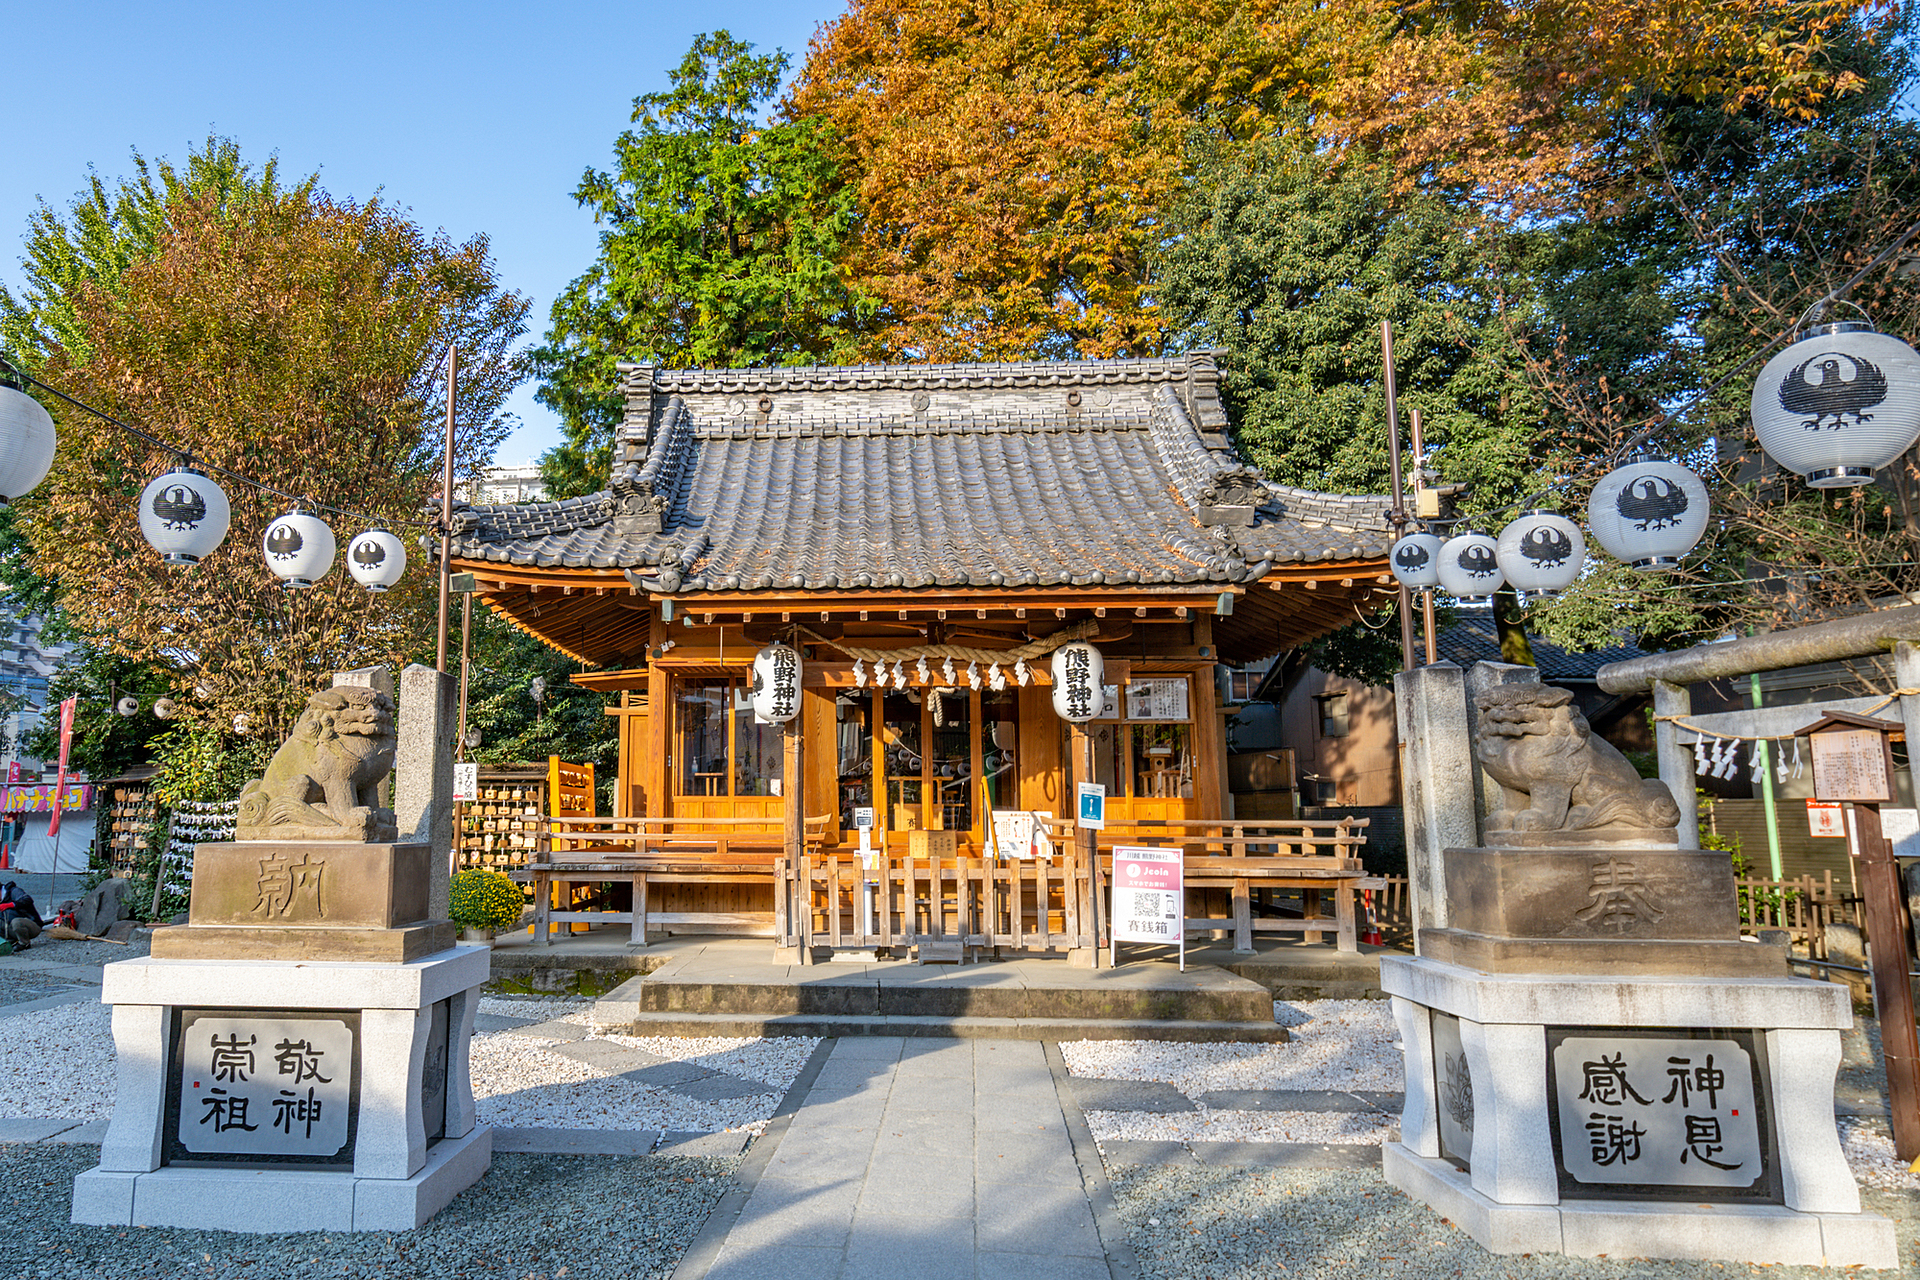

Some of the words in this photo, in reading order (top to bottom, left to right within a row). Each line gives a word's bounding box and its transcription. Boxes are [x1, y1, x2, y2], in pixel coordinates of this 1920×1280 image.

[771, 648, 797, 716] 熊野神社
[1065, 648, 1092, 717] 熊野神社
[3, 788, 84, 811] バナナチョコ
[250, 852, 329, 919] 納
[1575, 856, 1666, 934] 奉
[1128, 920, 1168, 934] 賽銭箱
[200, 1033, 259, 1134] 崇祖
[272, 1038, 333, 1139] 敬神
[1578, 1051, 1655, 1167] 感謝
[1661, 1054, 1744, 1171] 神恩
